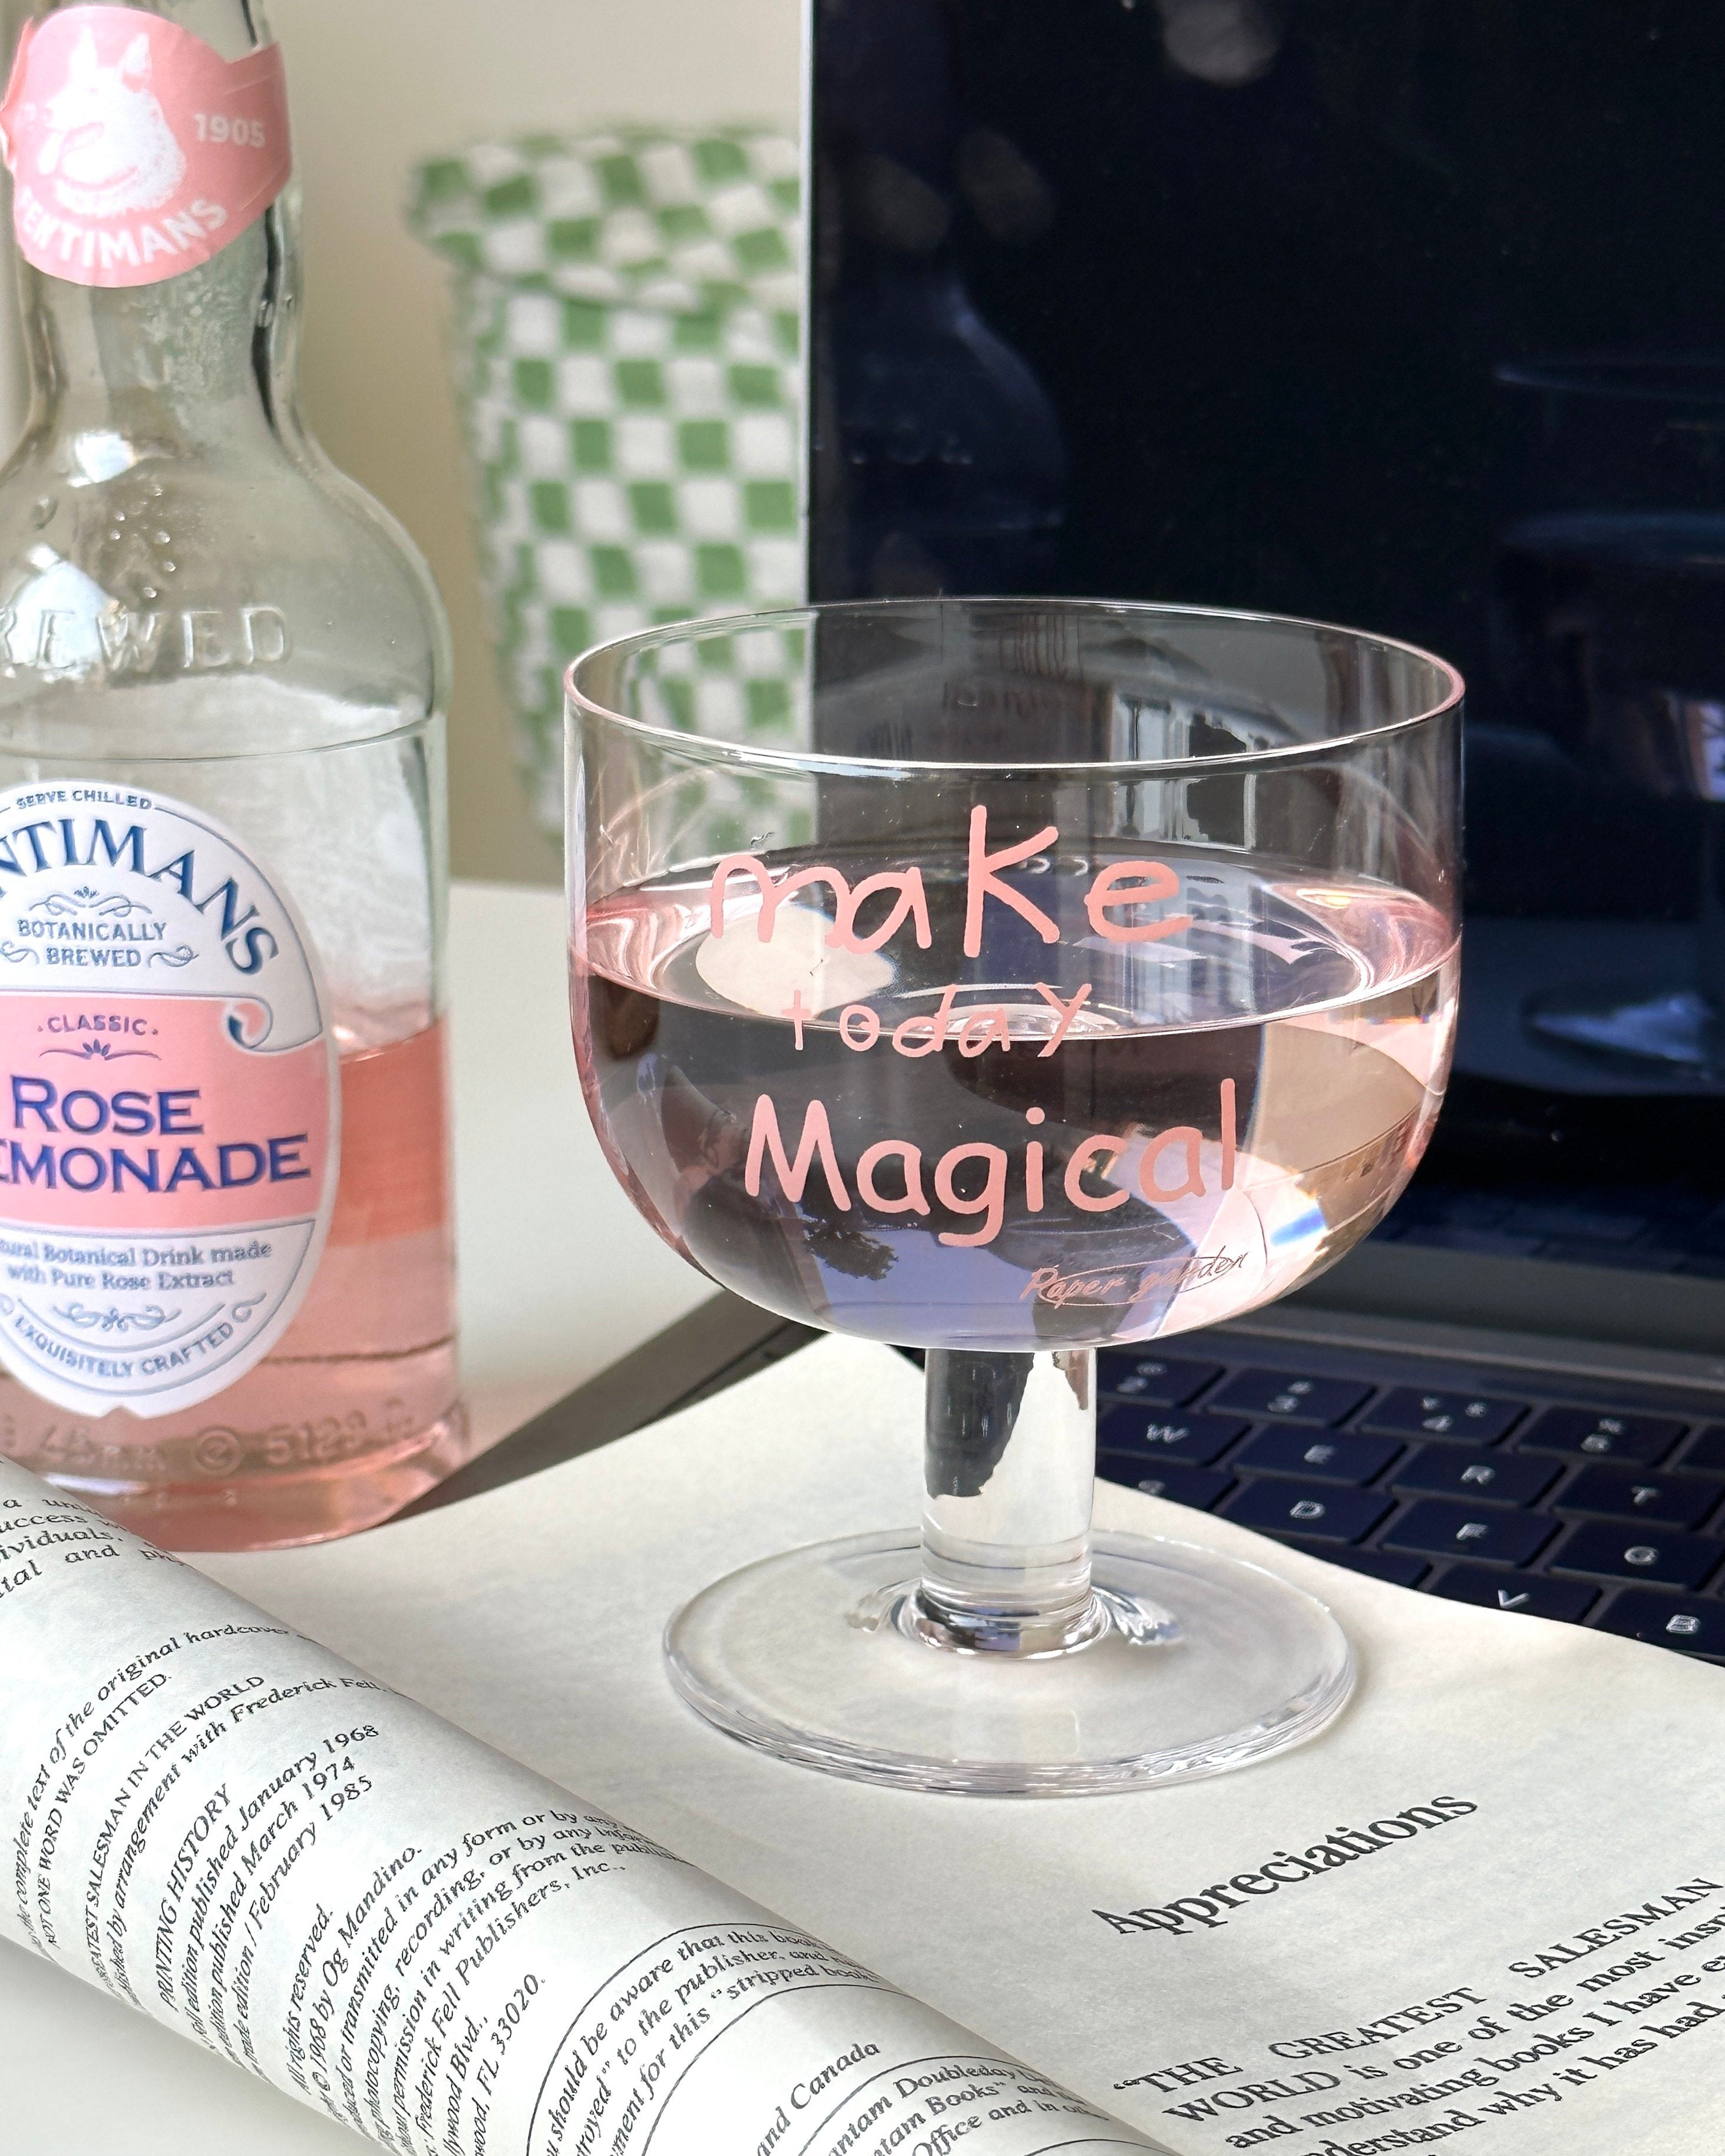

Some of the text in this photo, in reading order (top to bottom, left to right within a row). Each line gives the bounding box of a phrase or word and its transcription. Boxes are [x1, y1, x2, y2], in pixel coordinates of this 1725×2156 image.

[194, 114, 266, 148] 1905
[16, 790, 152, 810] SERVE CHILLED
[17, 919, 167, 941] BOTANICALLY
[46, 947, 141, 967] BREWED
[781, 983, 1092, 1058] today
[10, 1074, 205, 1136] ROSE
[0, 1132, 311, 1193] MONADE
[745, 1078, 1236, 1247] Magical
[7, 1263, 234, 1291] with Pure Rose Extract
[42, 1239, 272, 1267] Botanical Drink made
[15, 1315, 234, 1378] EXQUISITELY CRAFTED
[1146, 1423, 1191, 1444] W
[1289, 1500, 1326, 1519] D
[65, 1545, 121, 1563] and
[1497, 1589, 1532, 1609] V
[27, 1764, 50, 1810] text
[50, 1728, 67, 1764] of
[66, 1701, 94, 1737] the
[97, 1637, 183, 1701] original
[83, 1673, 173, 1757] OMITTED.
[322, 1725, 380, 1754] 1968
[55, 1757, 86, 1803] WAS
[87, 1676, 265, 1907] SALESMAN IN THE WORLD
[107, 1677, 338, 1938] by arrangement with Frederick
[239, 1752, 318, 1831] January
[38, 1808, 62, 1871] WORD
[463, 1821, 518, 1857] form
[522, 1811, 546, 1826] or
[550, 1810, 577, 1824] by
[37, 1874, 51, 1914] ONE
[156, 1782, 233, 2012] PRINTING HISTORY
[190, 1825, 239, 1951] published
[209, 1871, 248, 1993] published
[241, 1800, 298, 1876] March
[301, 1756, 355, 1800] 1974
[232, 1945, 254, 2019] edition
[249, 1822, 316, 1930] February
[319, 1774, 373, 1821] 1985
[338, 1847, 423, 1947] Mandino.
[421, 1847, 458, 1886] any
[1091, 1795, 1478, 1936] Appreciations
[395, 1886, 419, 1912] in
[395, 1869, 485, 1977] recording,
[489, 1847, 511, 1866] or
[517, 1834, 546, 1851] by
[553, 1827, 591, 1839] any
[181, 1944, 200, 2012] edition
[290, 1903, 333, 2011] reserved.
[322, 1947, 349, 1988] Og
[341, 1906, 398, 2045] transmitted
[393, 1989, 427, 2118] permission
[420, 1960, 441, 1988] in
[438, 1880, 513, 1956] writing
[511, 1850, 567, 1890] from
[570, 1843, 606, 1857] the
[1268, 1986, 1488, 2059] GREATEST
[1508, 1877, 1724, 1978] SALESMAN
[312, 1989, 335, 2021] by
[415, 2036, 441, 2140] Frederick
[431, 1982, 461, 2038] Fell
[455, 1879, 570, 1986] Publishers,
[477, 2058, 499, 2097] FL
[491, 1974, 546, 2055] 33020.
[548, 1930, 769, 2142] should be aware that this
[617, 2038, 636, 2065] to
[638, 1999, 673, 2036] the
[675, 1950, 786, 2006] publisher,
[1161, 1950, 1666, 2122] WORLD is one of the most
[283, 2010, 306, 2070] rights
[309, 2018, 327, 2074] 1968
[341, 2043, 352, 2072] or
[640, 2048, 666, 2101] for
[669, 2007, 711, 2051] this
[1225, 1973, 1702, 2149] and motivating books I have
[1478, 2083, 1563, 2115] why
[1552, 2068, 1598, 2086] it
[1577, 2038, 1658, 2071] has
[1639, 2001, 1725, 2038] had
[791, 2042, 881, 2109] Canada
[893, 2065, 1016, 2099] Doubleday
[989, 2099, 1032, 2121] and
[1033, 2100, 1060, 2112] in
